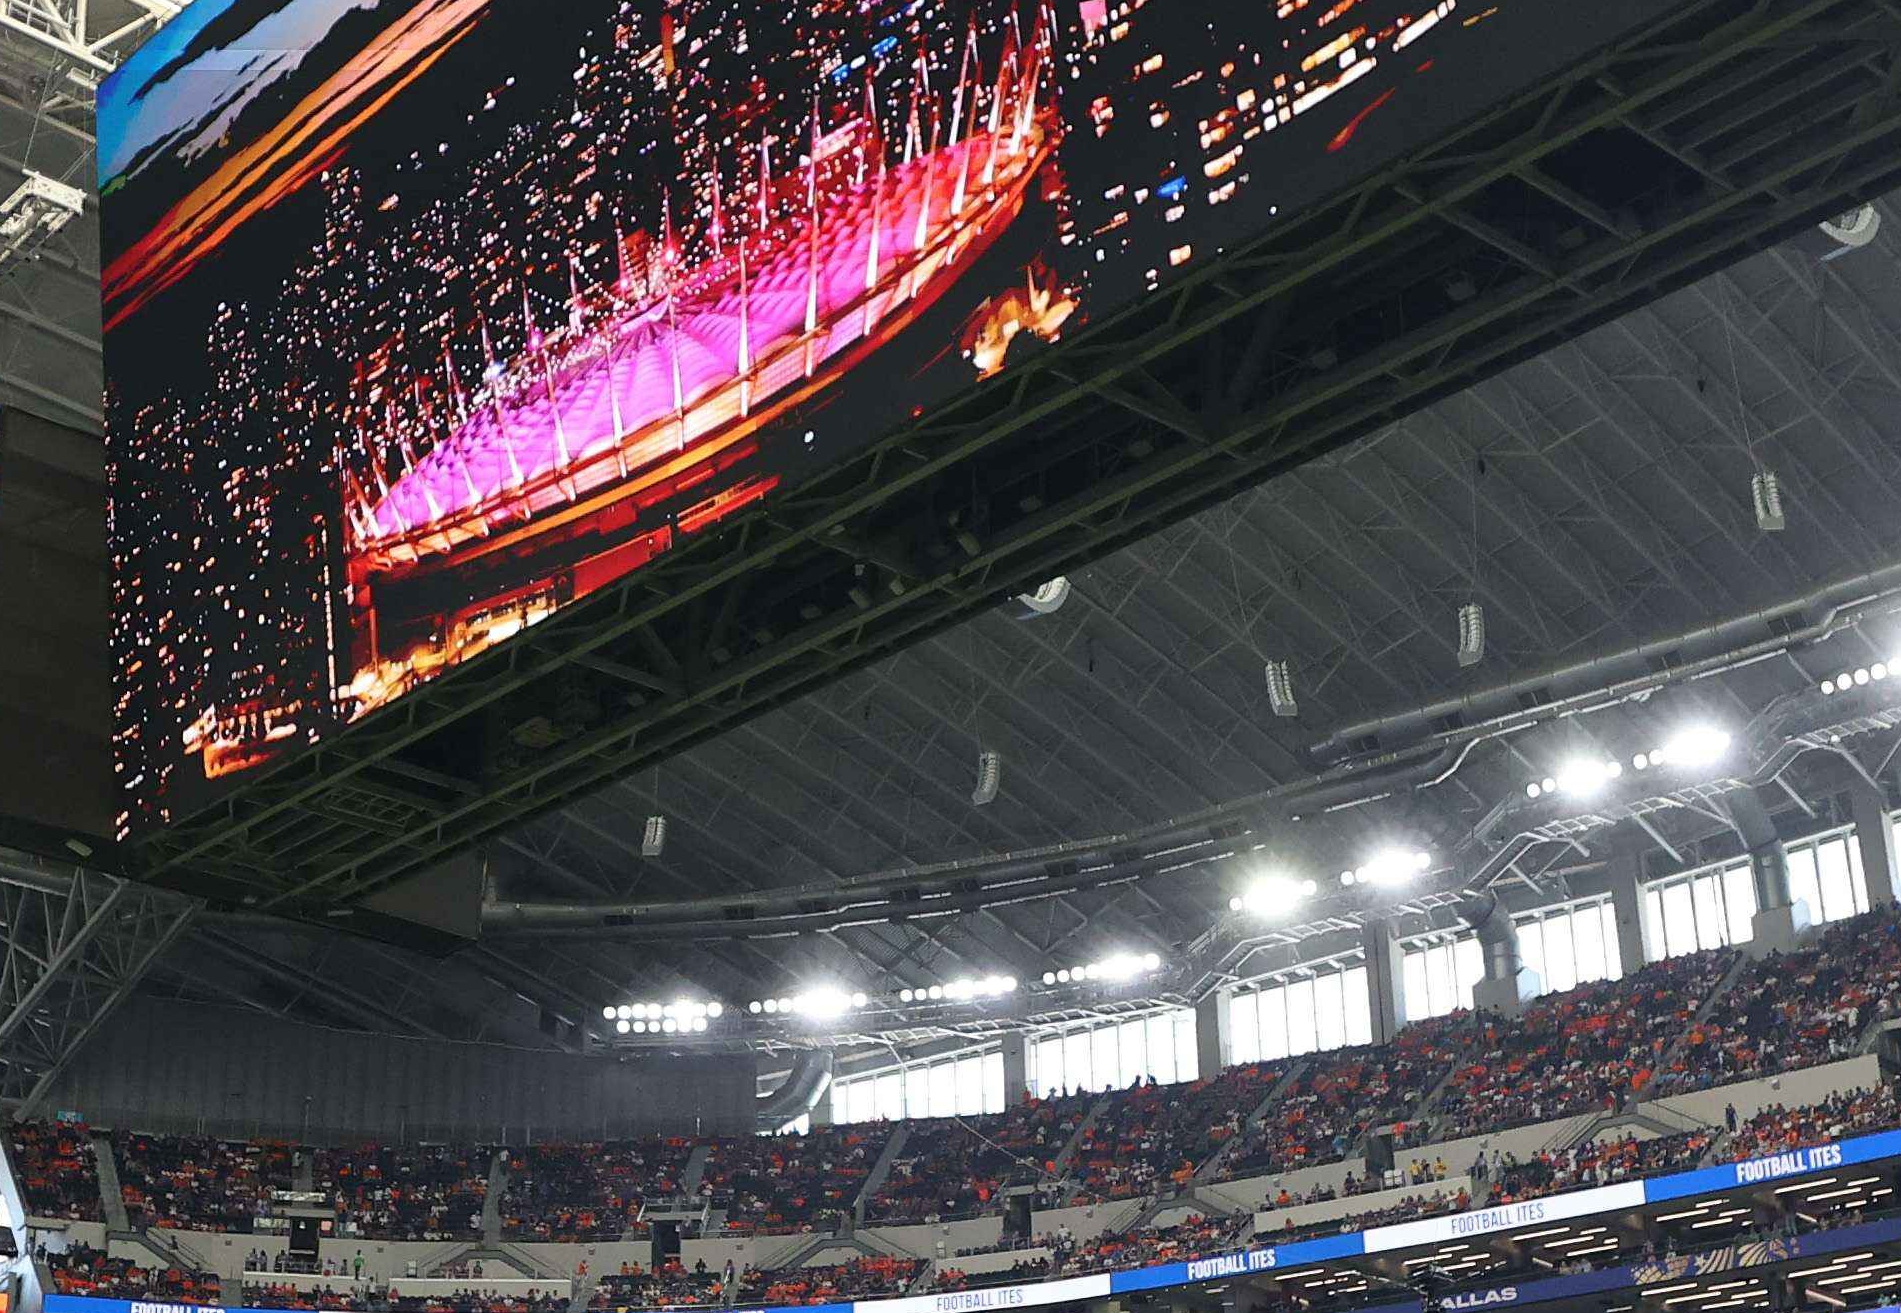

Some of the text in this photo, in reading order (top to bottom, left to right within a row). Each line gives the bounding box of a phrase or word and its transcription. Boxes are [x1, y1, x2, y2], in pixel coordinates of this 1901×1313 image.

[1737, 1153, 1807, 1181] FOOTBALL
[1451, 1209, 1513, 1234] FOOTBALL
[1188, 1255, 1247, 1278] FOOTBALL
[937, 1289, 992, 1313] FOOTBALL
[1440, 1287, 1518, 1309] ALLAS
